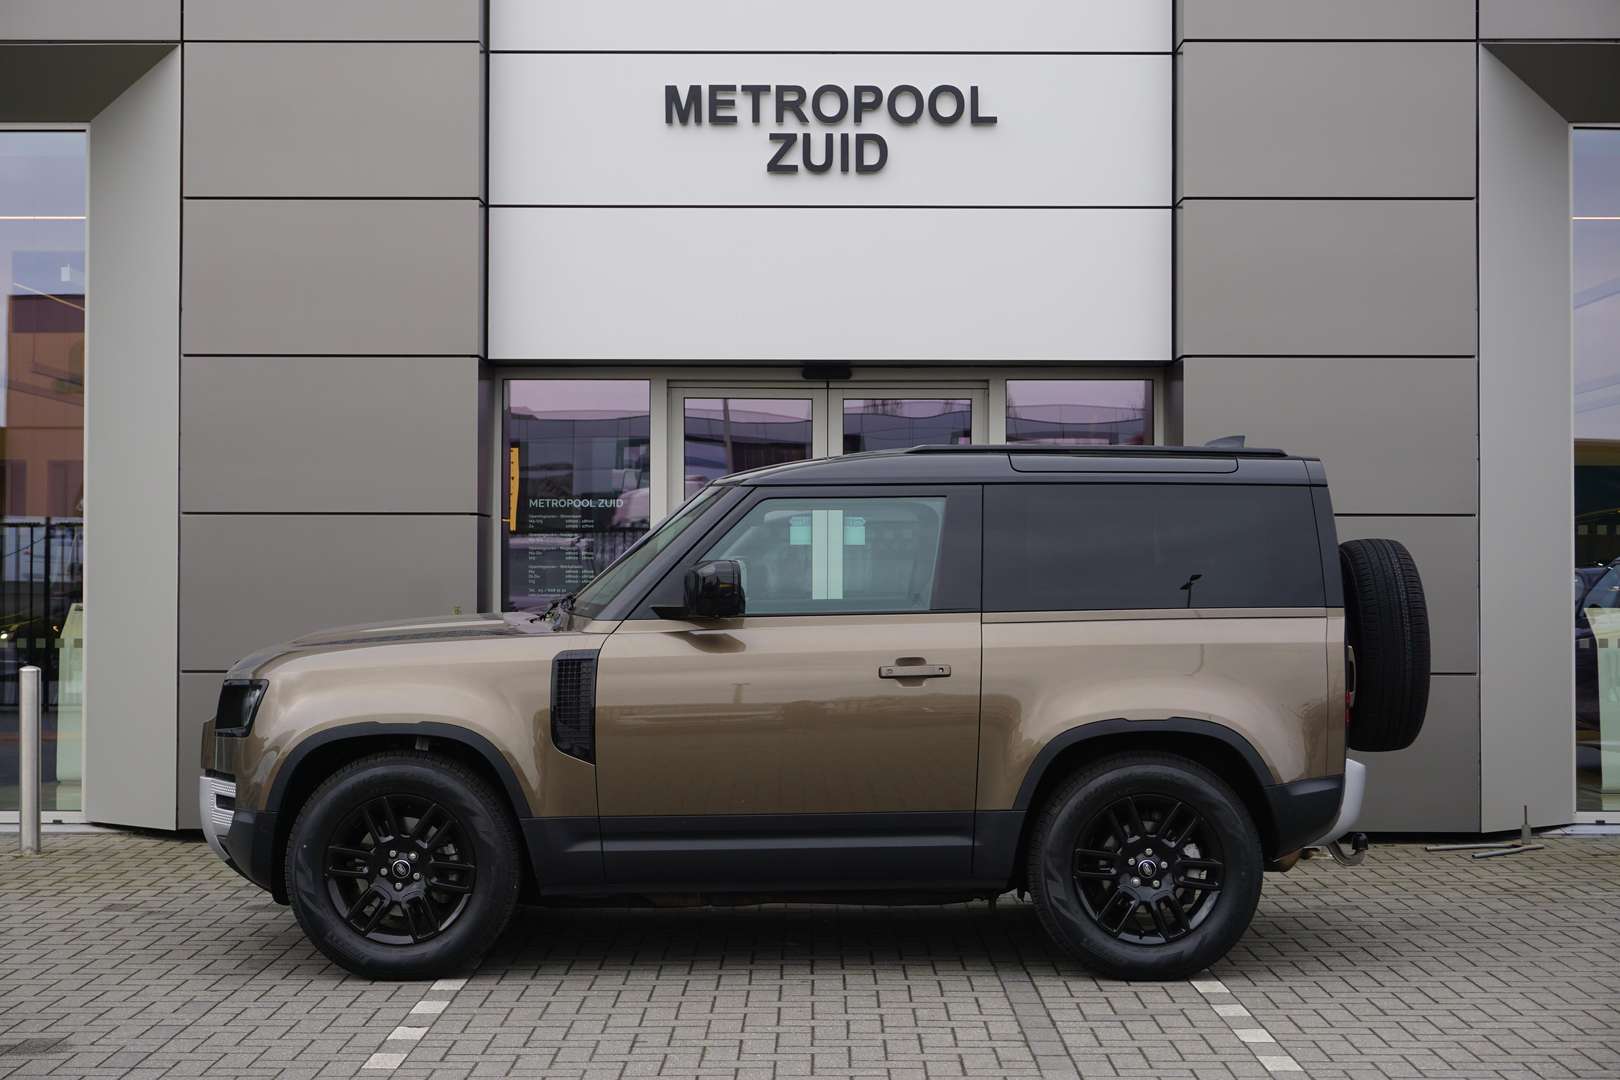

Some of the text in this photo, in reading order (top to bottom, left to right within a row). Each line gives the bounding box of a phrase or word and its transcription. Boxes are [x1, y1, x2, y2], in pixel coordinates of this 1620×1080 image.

[664, 84, 998, 125] METROPOOL
[766, 132, 889, 173] ZUID
[529, 498, 624, 508] METROPOOL ZUID
